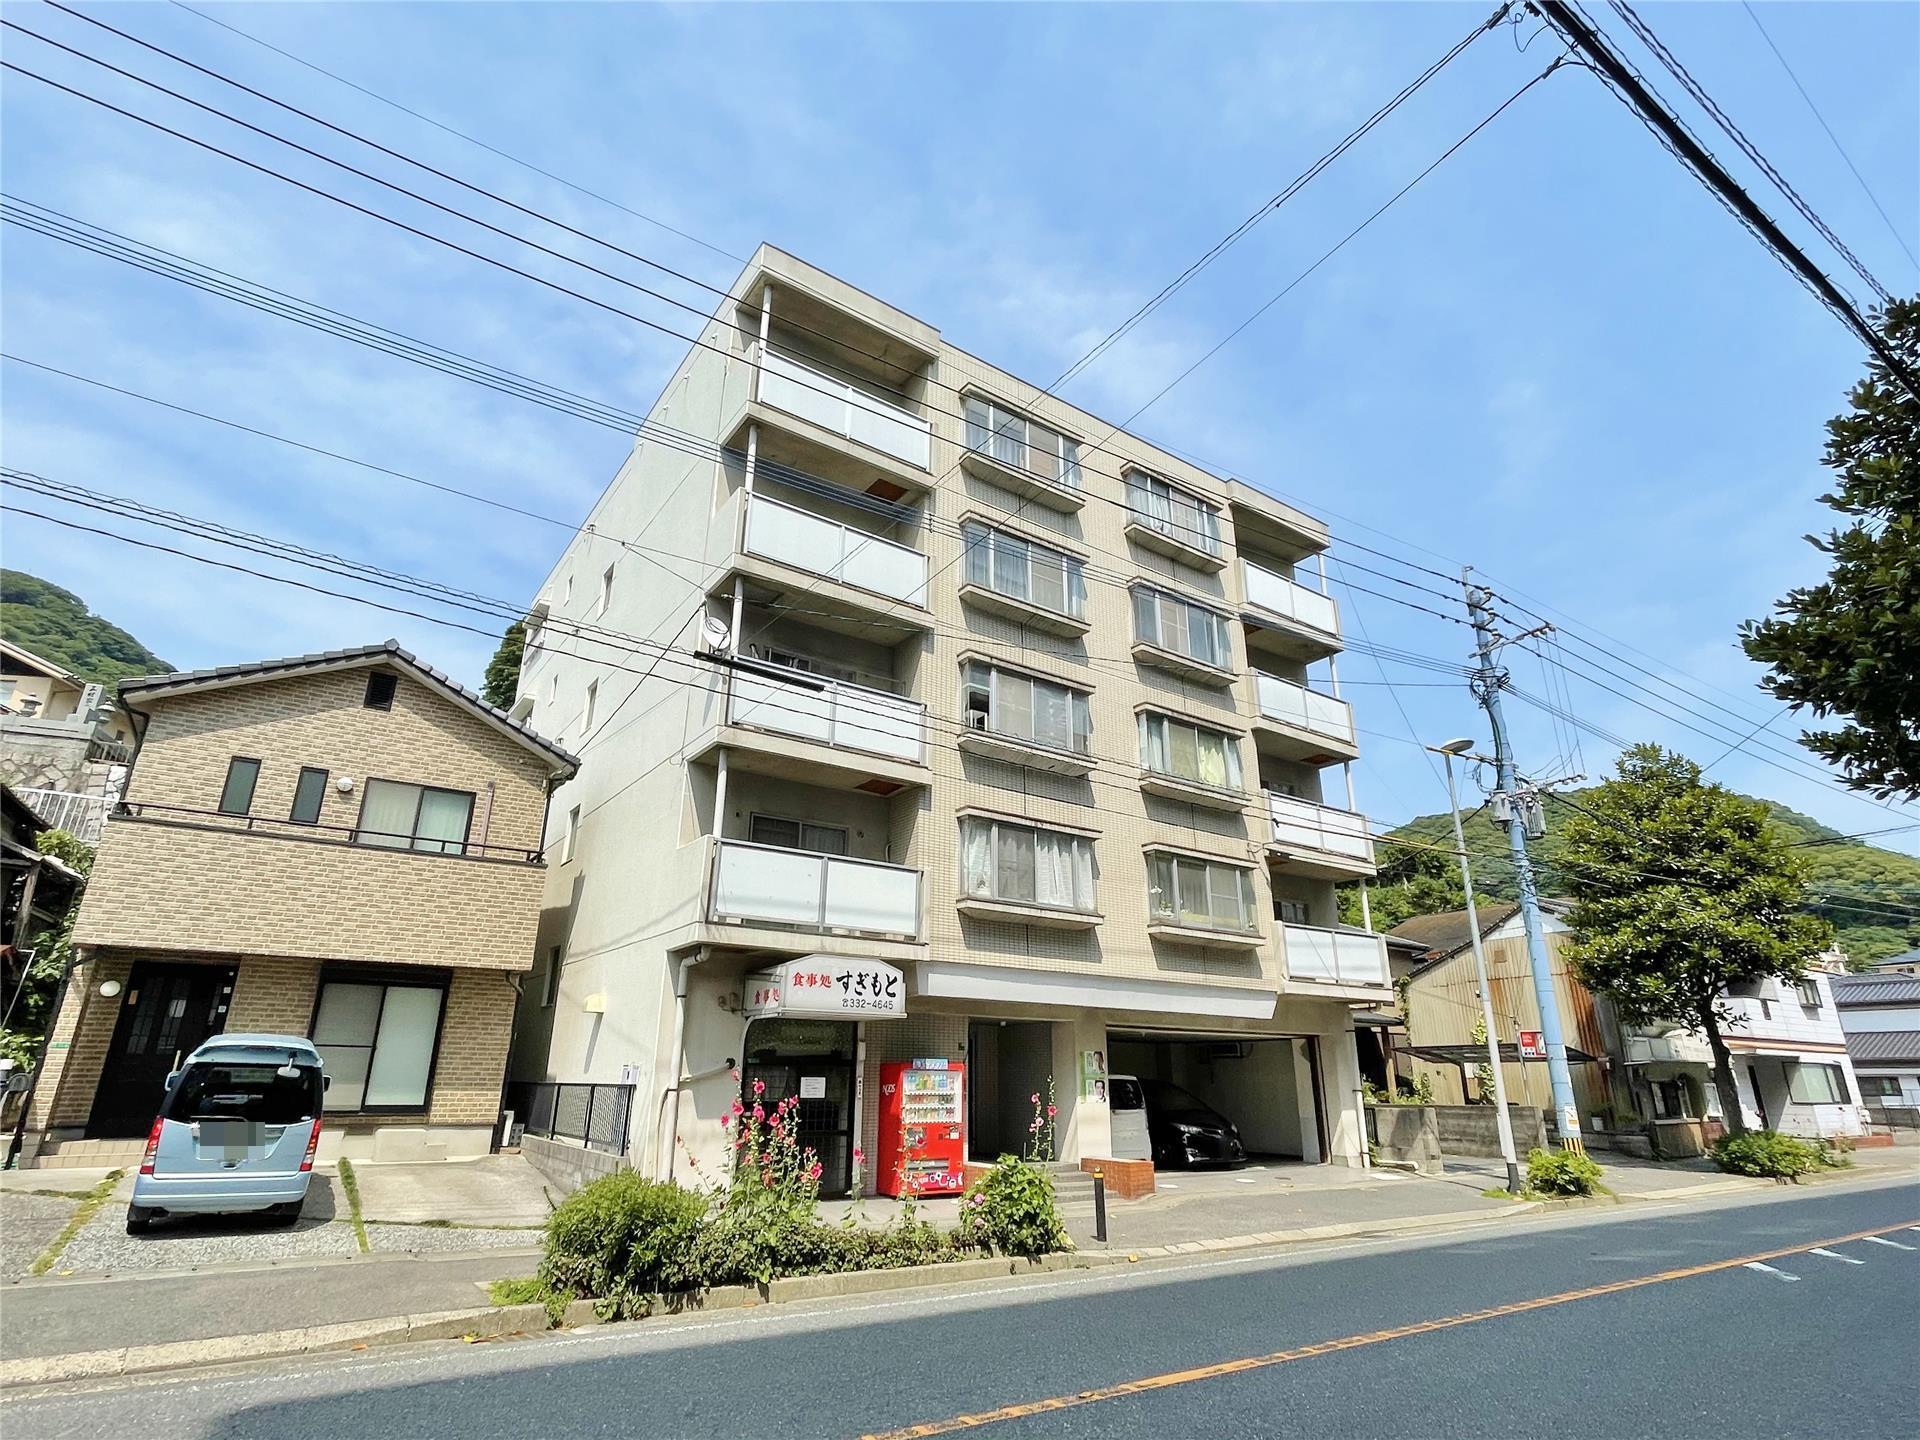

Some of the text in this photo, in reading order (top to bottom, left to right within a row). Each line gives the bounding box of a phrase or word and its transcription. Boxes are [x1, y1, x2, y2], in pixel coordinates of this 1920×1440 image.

[793, 970, 898, 998] 食事処 すぎもと
[850, 998, 894, 1010] 332-4645
